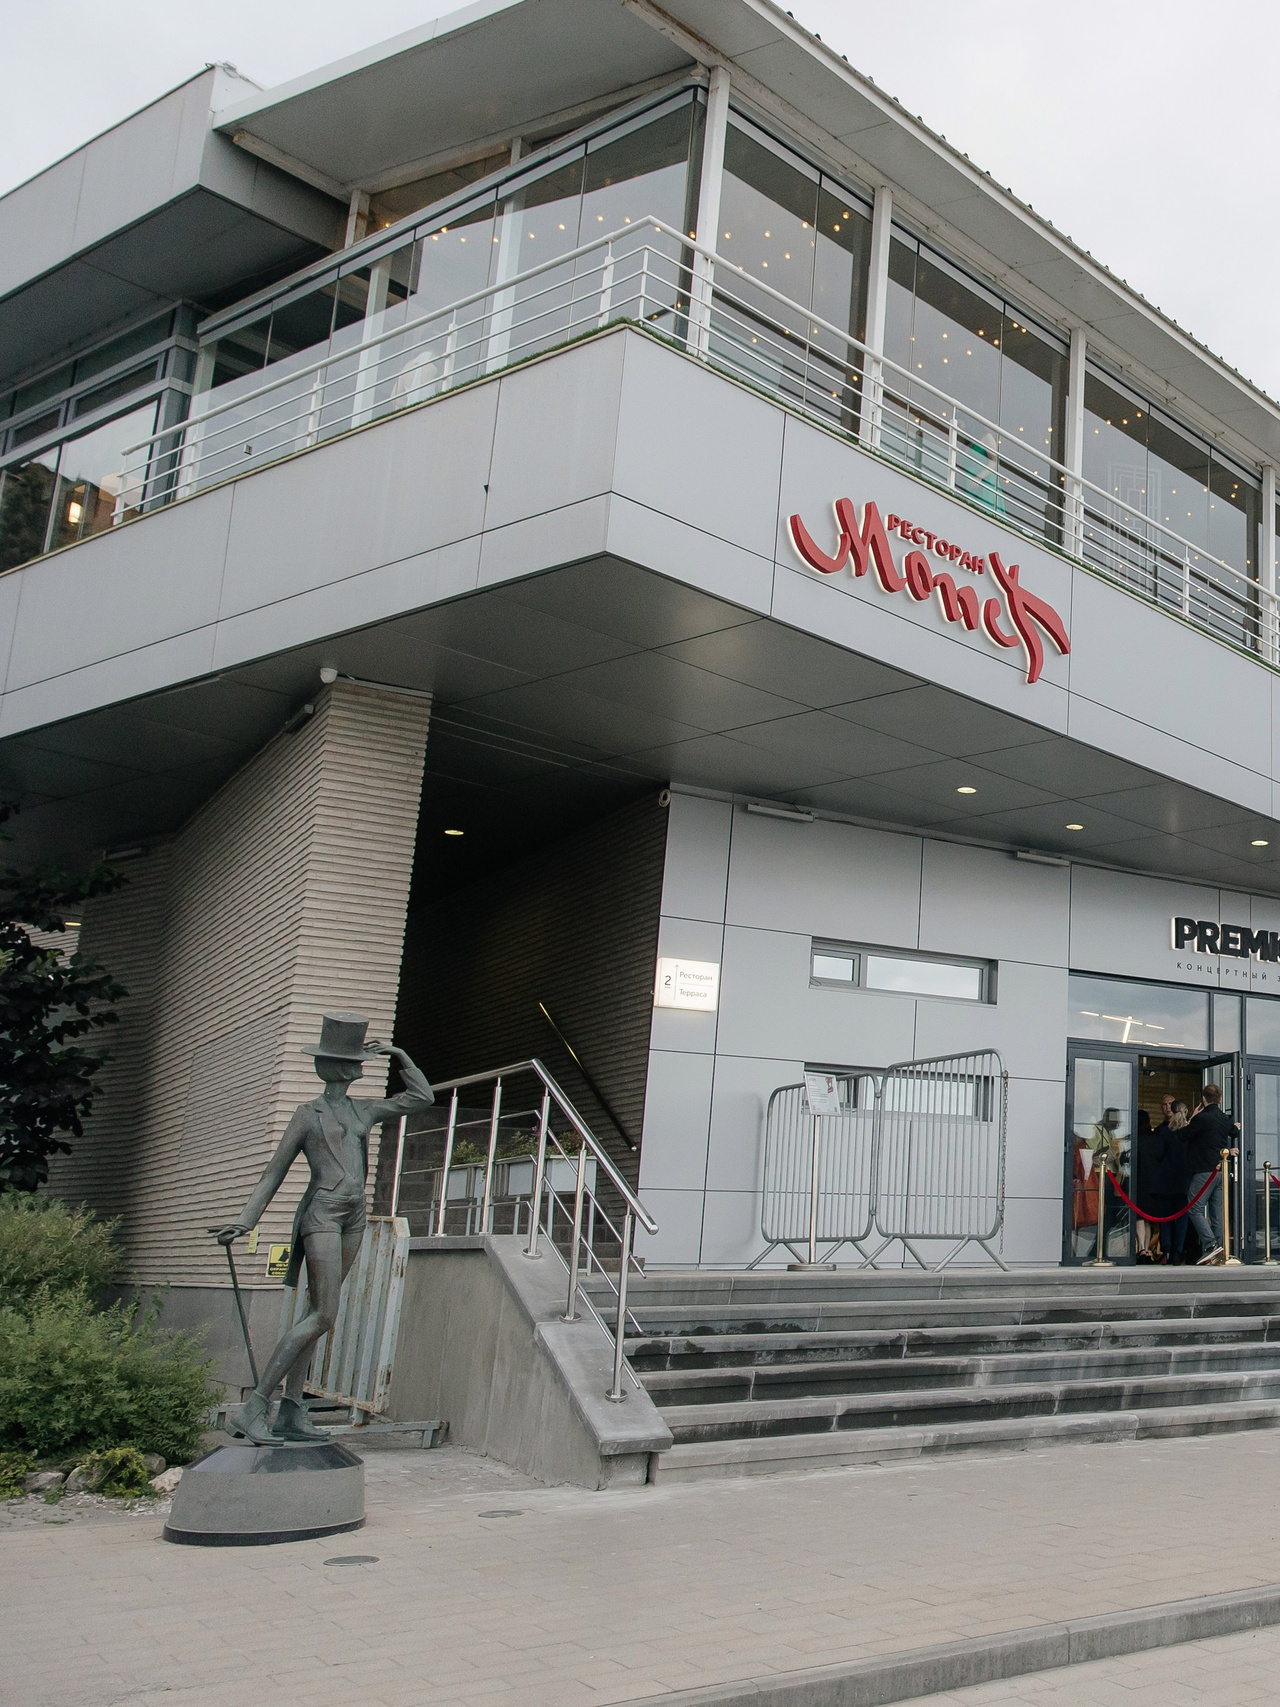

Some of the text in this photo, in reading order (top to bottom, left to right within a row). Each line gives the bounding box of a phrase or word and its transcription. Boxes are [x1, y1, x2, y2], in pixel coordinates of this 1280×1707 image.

[887, 513, 986, 575] РЕСТОРАН
[679, 971, 713, 981] Ресторан
[1176, 962, 1267, 981] КОНЦЕРТНЫЙ
[664, 975, 672, 986] 2
[679, 988, 708, 998] Терраса
